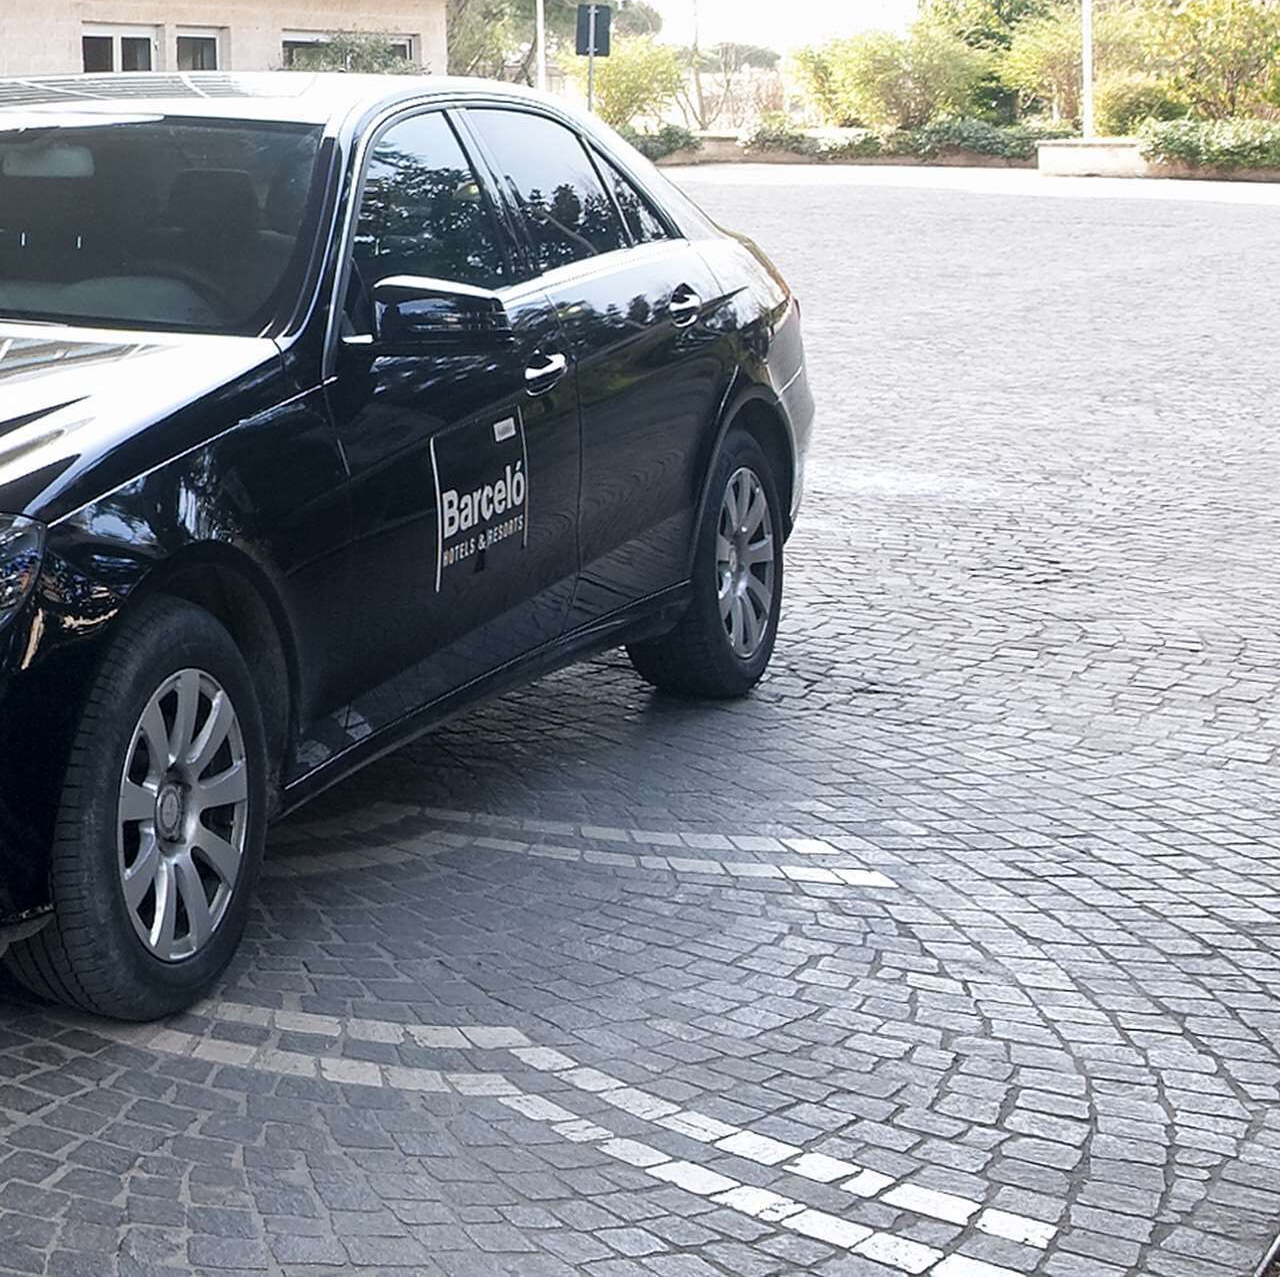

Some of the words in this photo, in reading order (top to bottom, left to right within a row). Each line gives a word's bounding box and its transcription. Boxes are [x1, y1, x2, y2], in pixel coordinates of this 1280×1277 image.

[442, 460, 524, 539] Barceló
[443, 538, 476, 567] HOTELS
[478, 533, 487, 551] &
[487, 514, 523, 546] RESORTS
